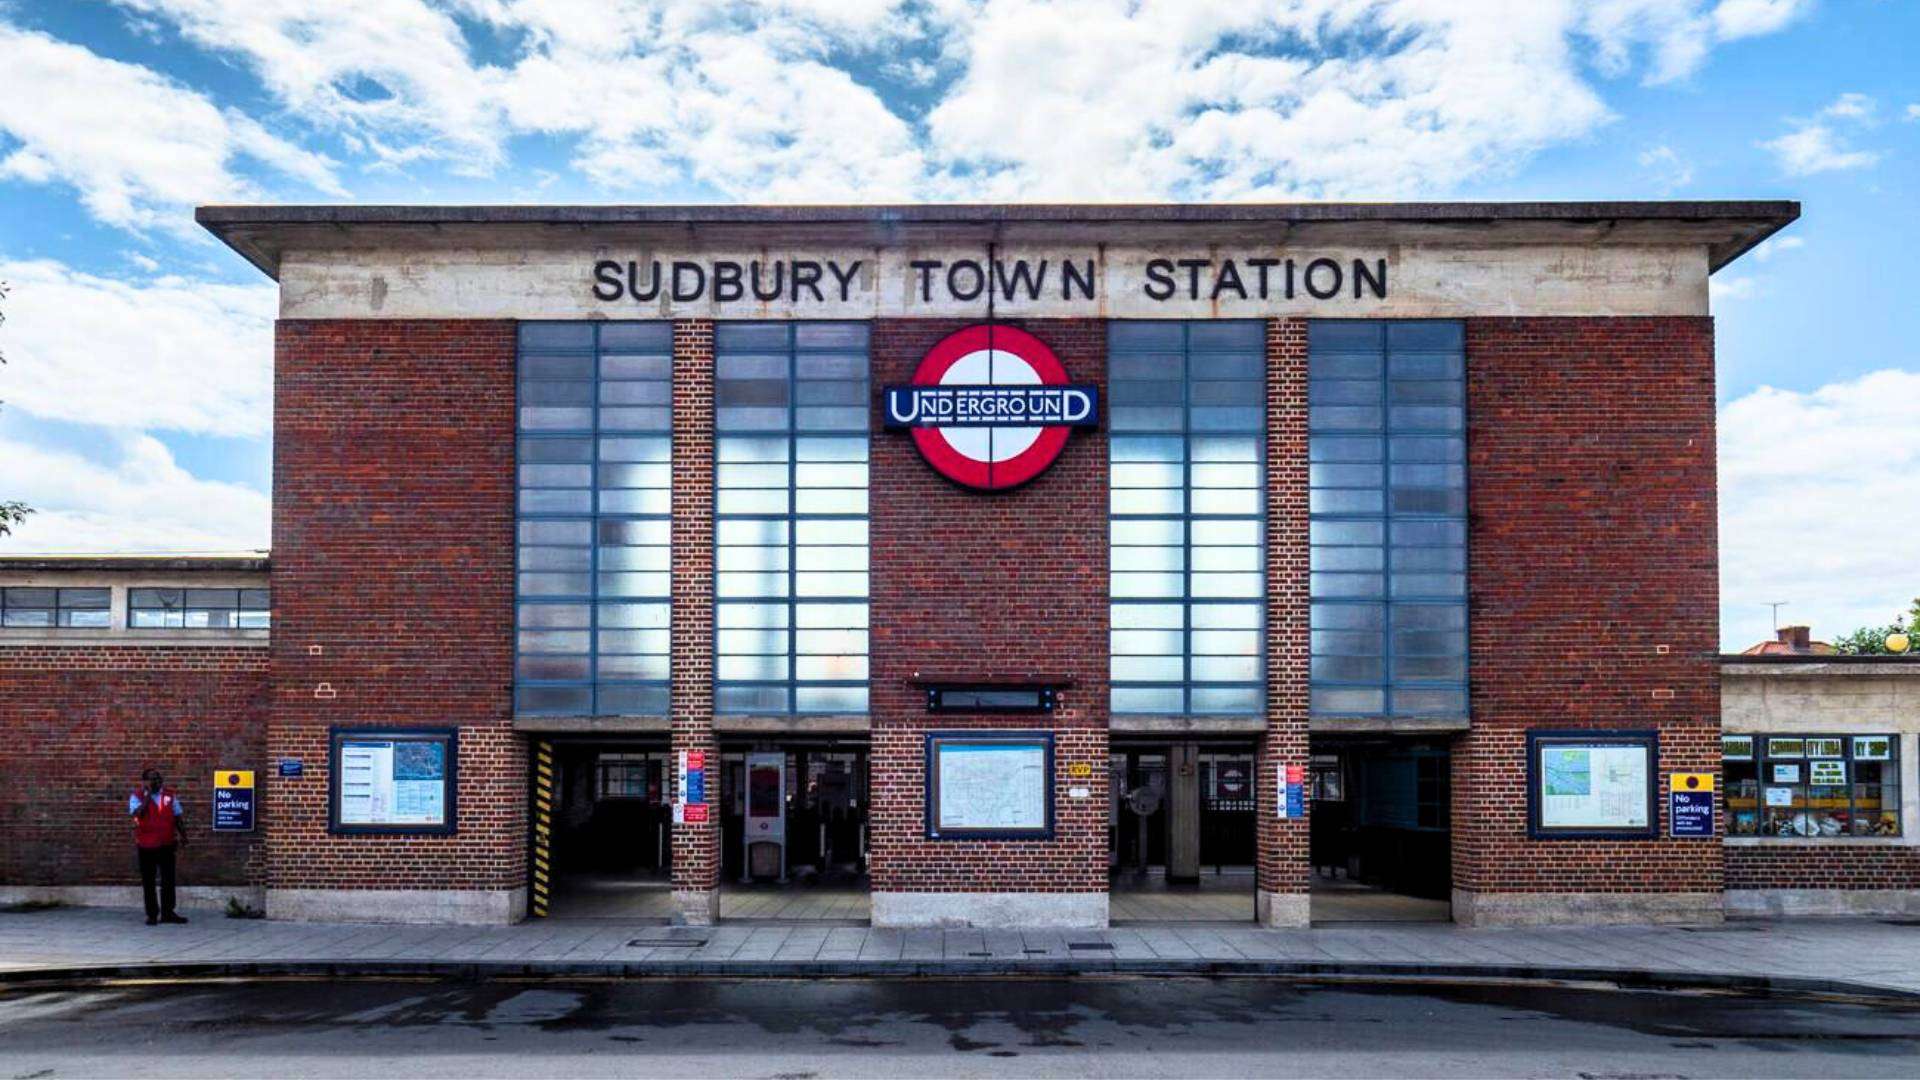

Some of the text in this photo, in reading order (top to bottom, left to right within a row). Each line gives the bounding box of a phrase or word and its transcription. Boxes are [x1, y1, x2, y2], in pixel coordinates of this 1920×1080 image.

[592, 258, 1387, 302] SUDBURY TOWN STATION
[890, 389, 1091, 422] UNDERGROUND
[217, 790, 231, 799] No
[1675, 794, 1690, 803] No
[217, 800, 249, 811] parking
[1675, 804, 1710, 816] parking
